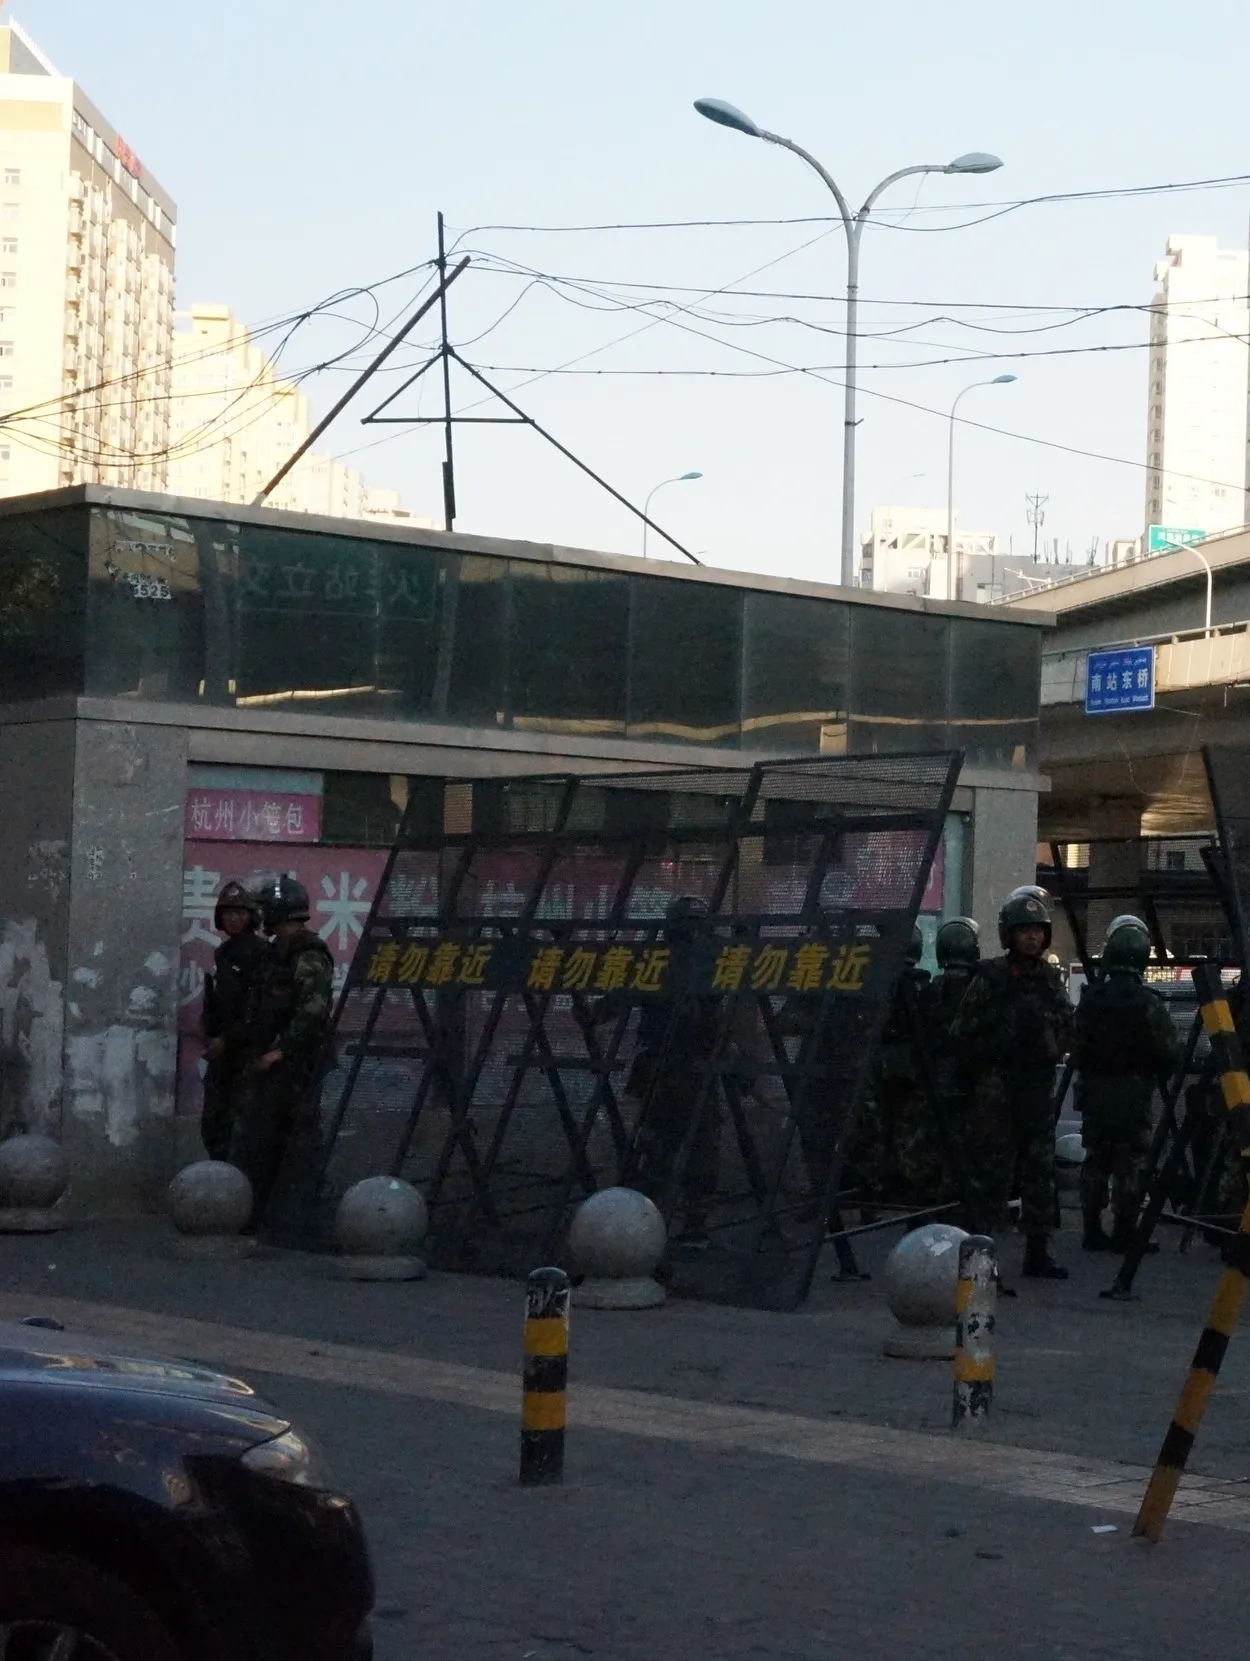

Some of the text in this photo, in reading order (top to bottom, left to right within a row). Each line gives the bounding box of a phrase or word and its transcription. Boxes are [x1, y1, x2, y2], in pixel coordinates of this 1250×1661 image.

[1091, 668, 1149, 692] 南站东桥
[367, 941, 494, 985] 请勿靠近
[527, 945, 670, 992] 请勿靠近
[713, 944, 871, 991] 请勿靠近
